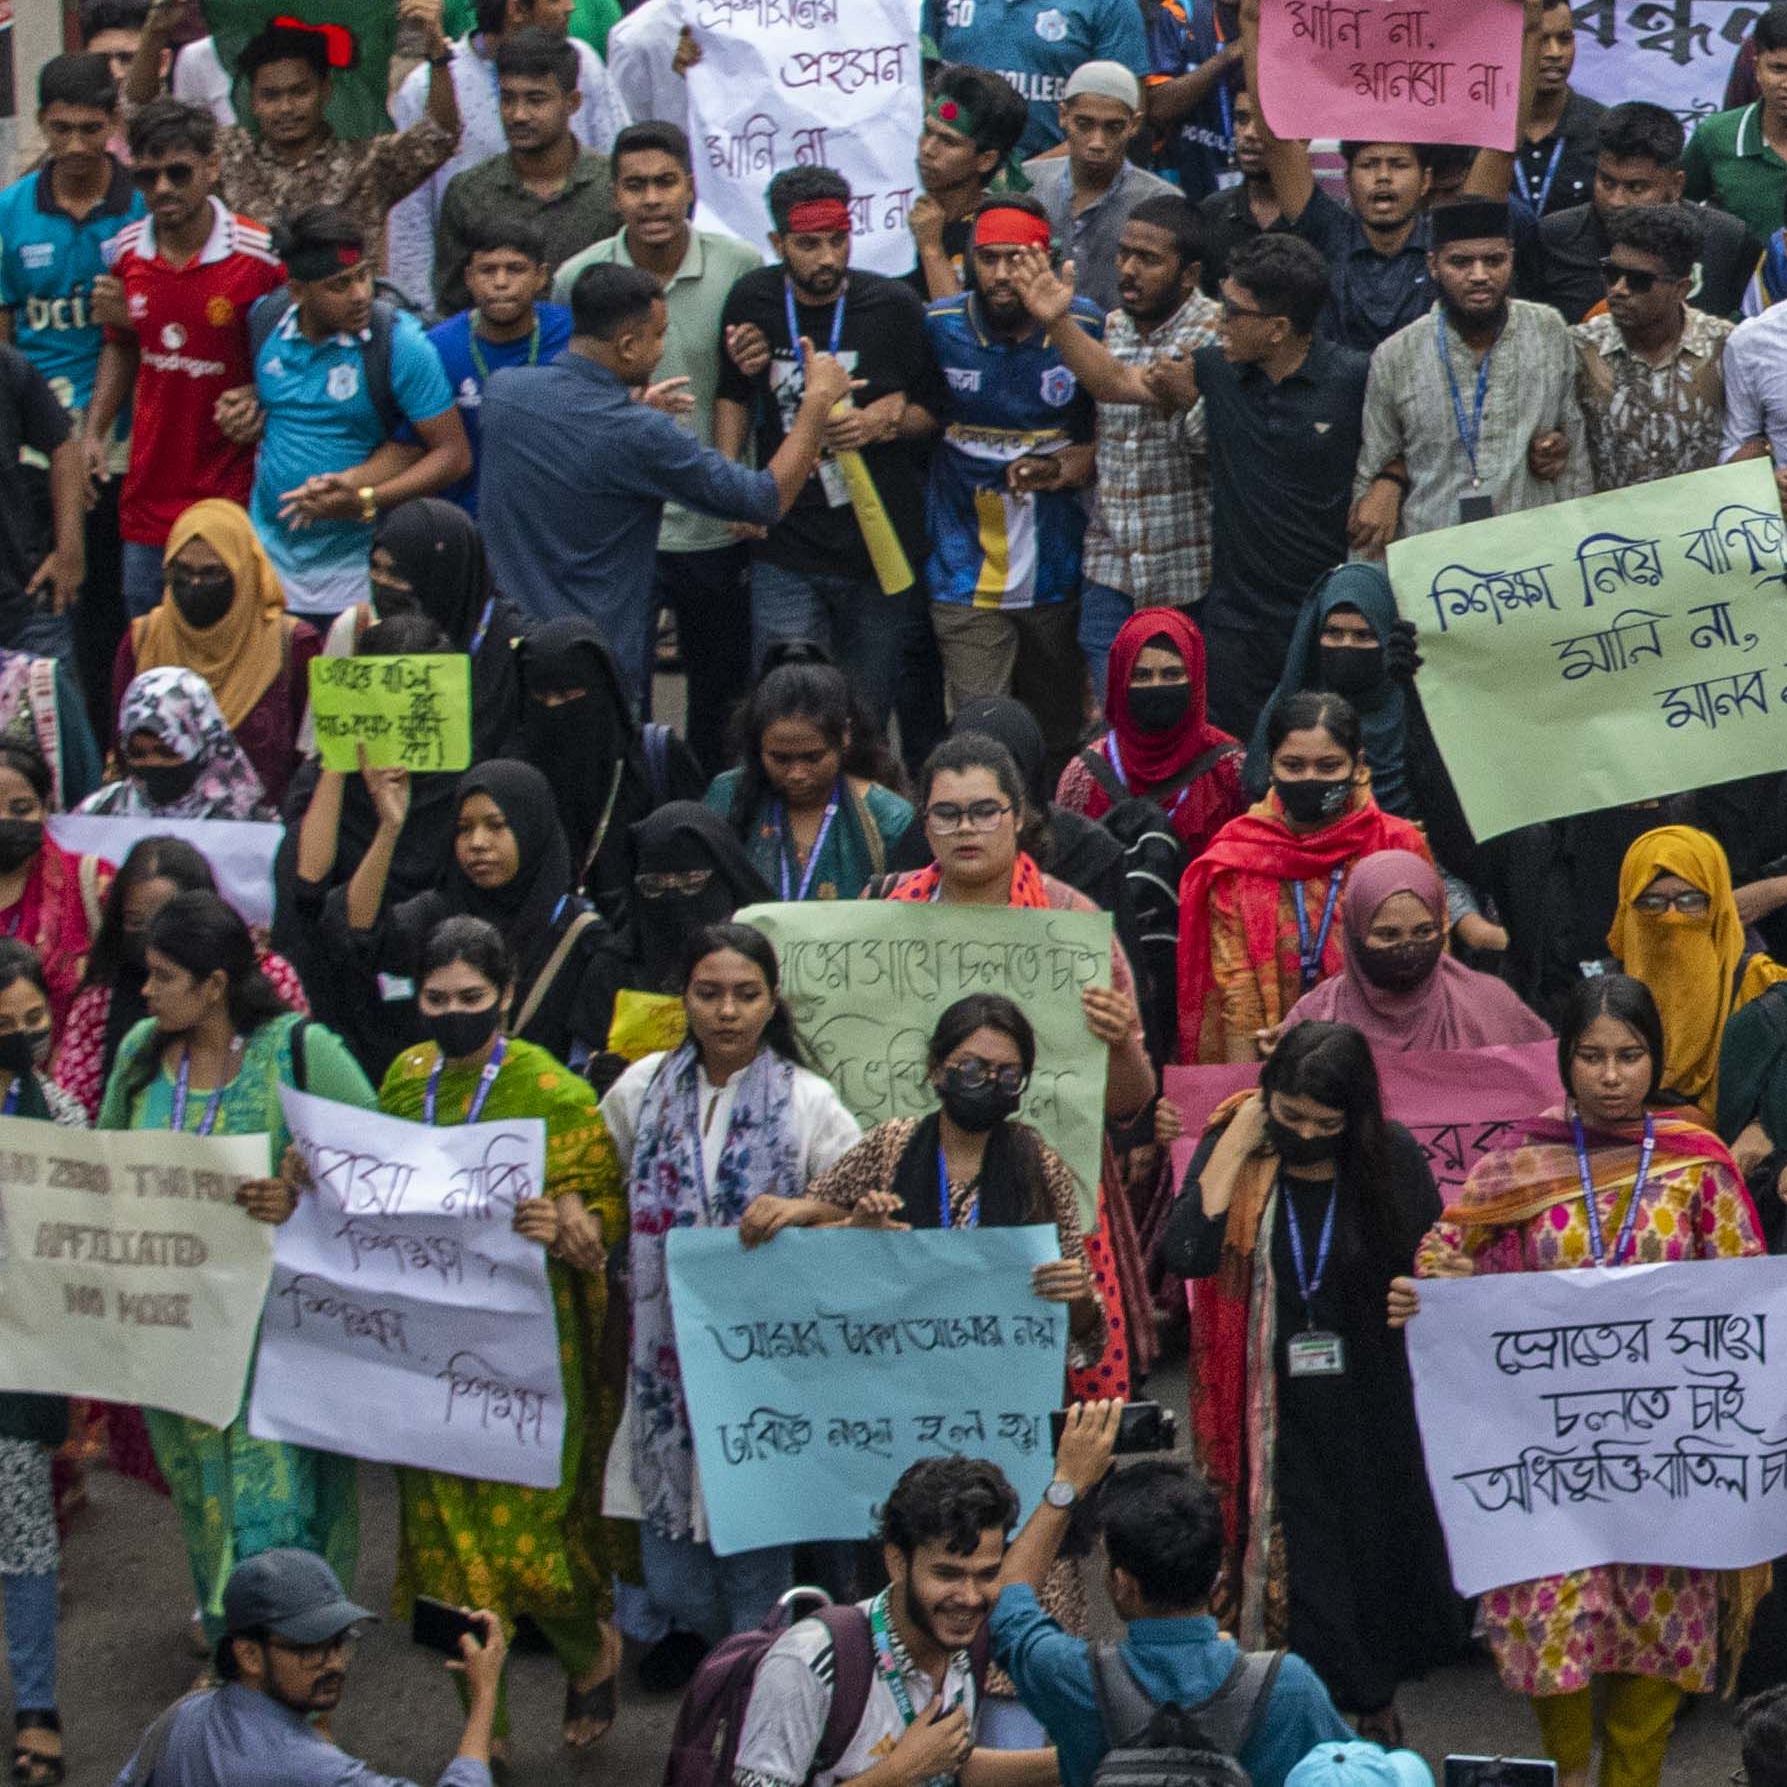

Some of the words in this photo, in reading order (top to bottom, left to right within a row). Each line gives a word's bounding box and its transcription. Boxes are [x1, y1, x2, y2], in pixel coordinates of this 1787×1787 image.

[1429, 560, 1558, 634] শিক্ষা
[1577, 530, 1666, 609] নিয়ে
[1550, 604, 1674, 681] মানি
[1653, 669, 1776, 731] মানব
[1664, 1311, 1768, 1366] সাথে
[1541, 1384, 1679, 1439] চলতে
[1682, 1368, 1766, 1437] চাই
